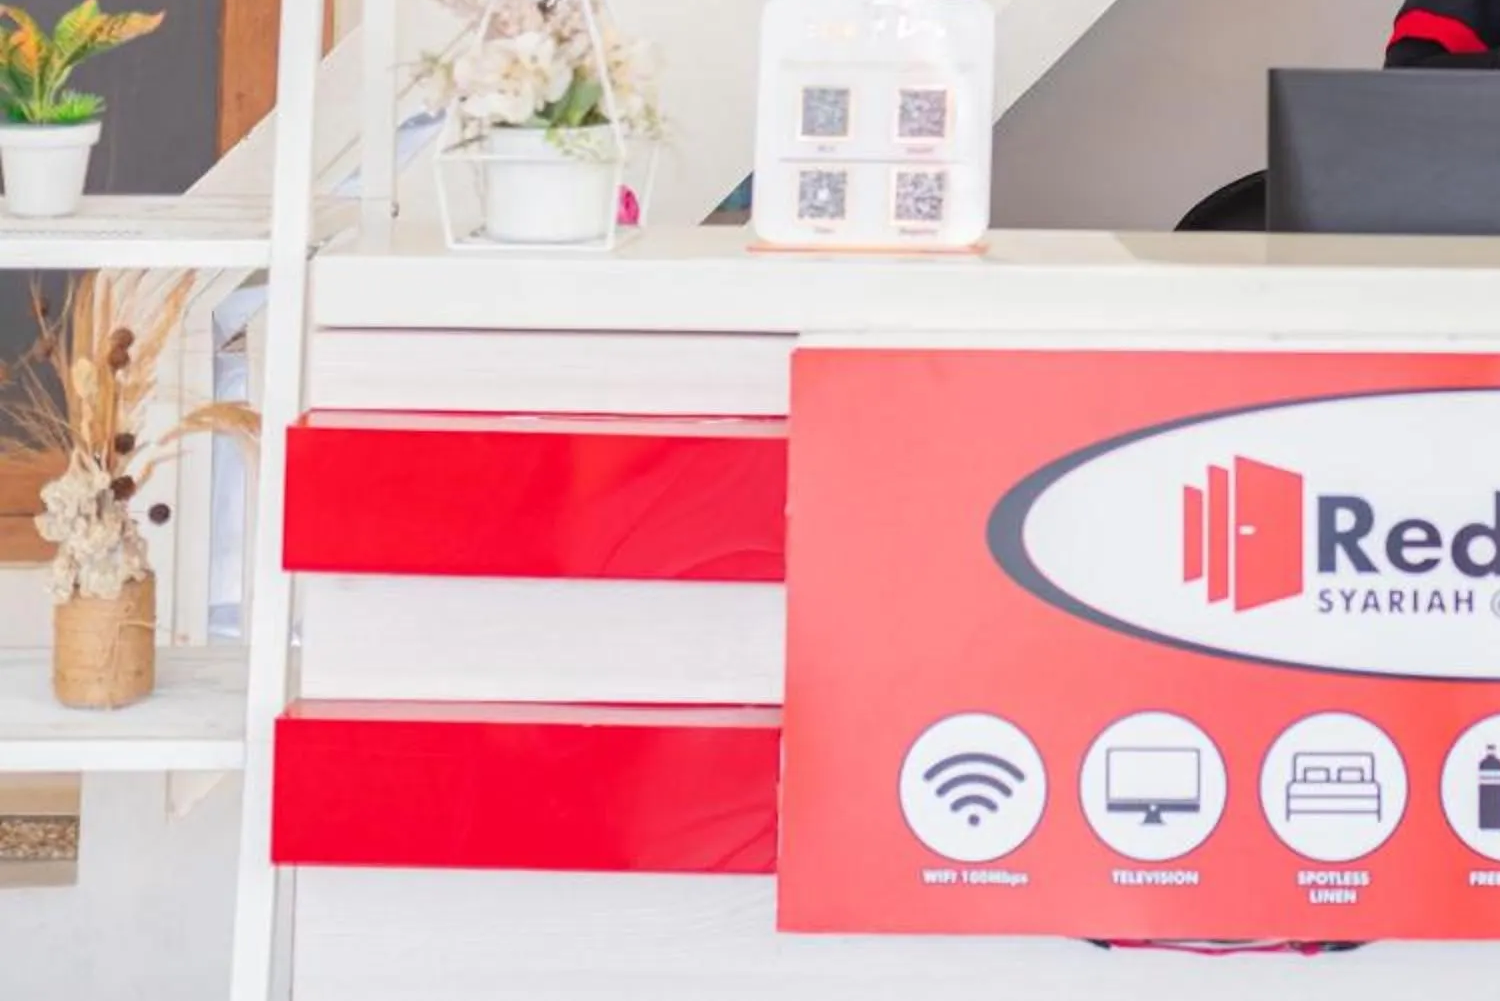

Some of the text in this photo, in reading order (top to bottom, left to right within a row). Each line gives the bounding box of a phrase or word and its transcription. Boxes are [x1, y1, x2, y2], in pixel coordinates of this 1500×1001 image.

[1317, 589, 1475, 615] SYARIAH
[1111, 870, 1199, 886] TELEVISION
[1297, 870, 1370, 886] SPOTLESS
[1309, 888, 1357, 904] LINEN
